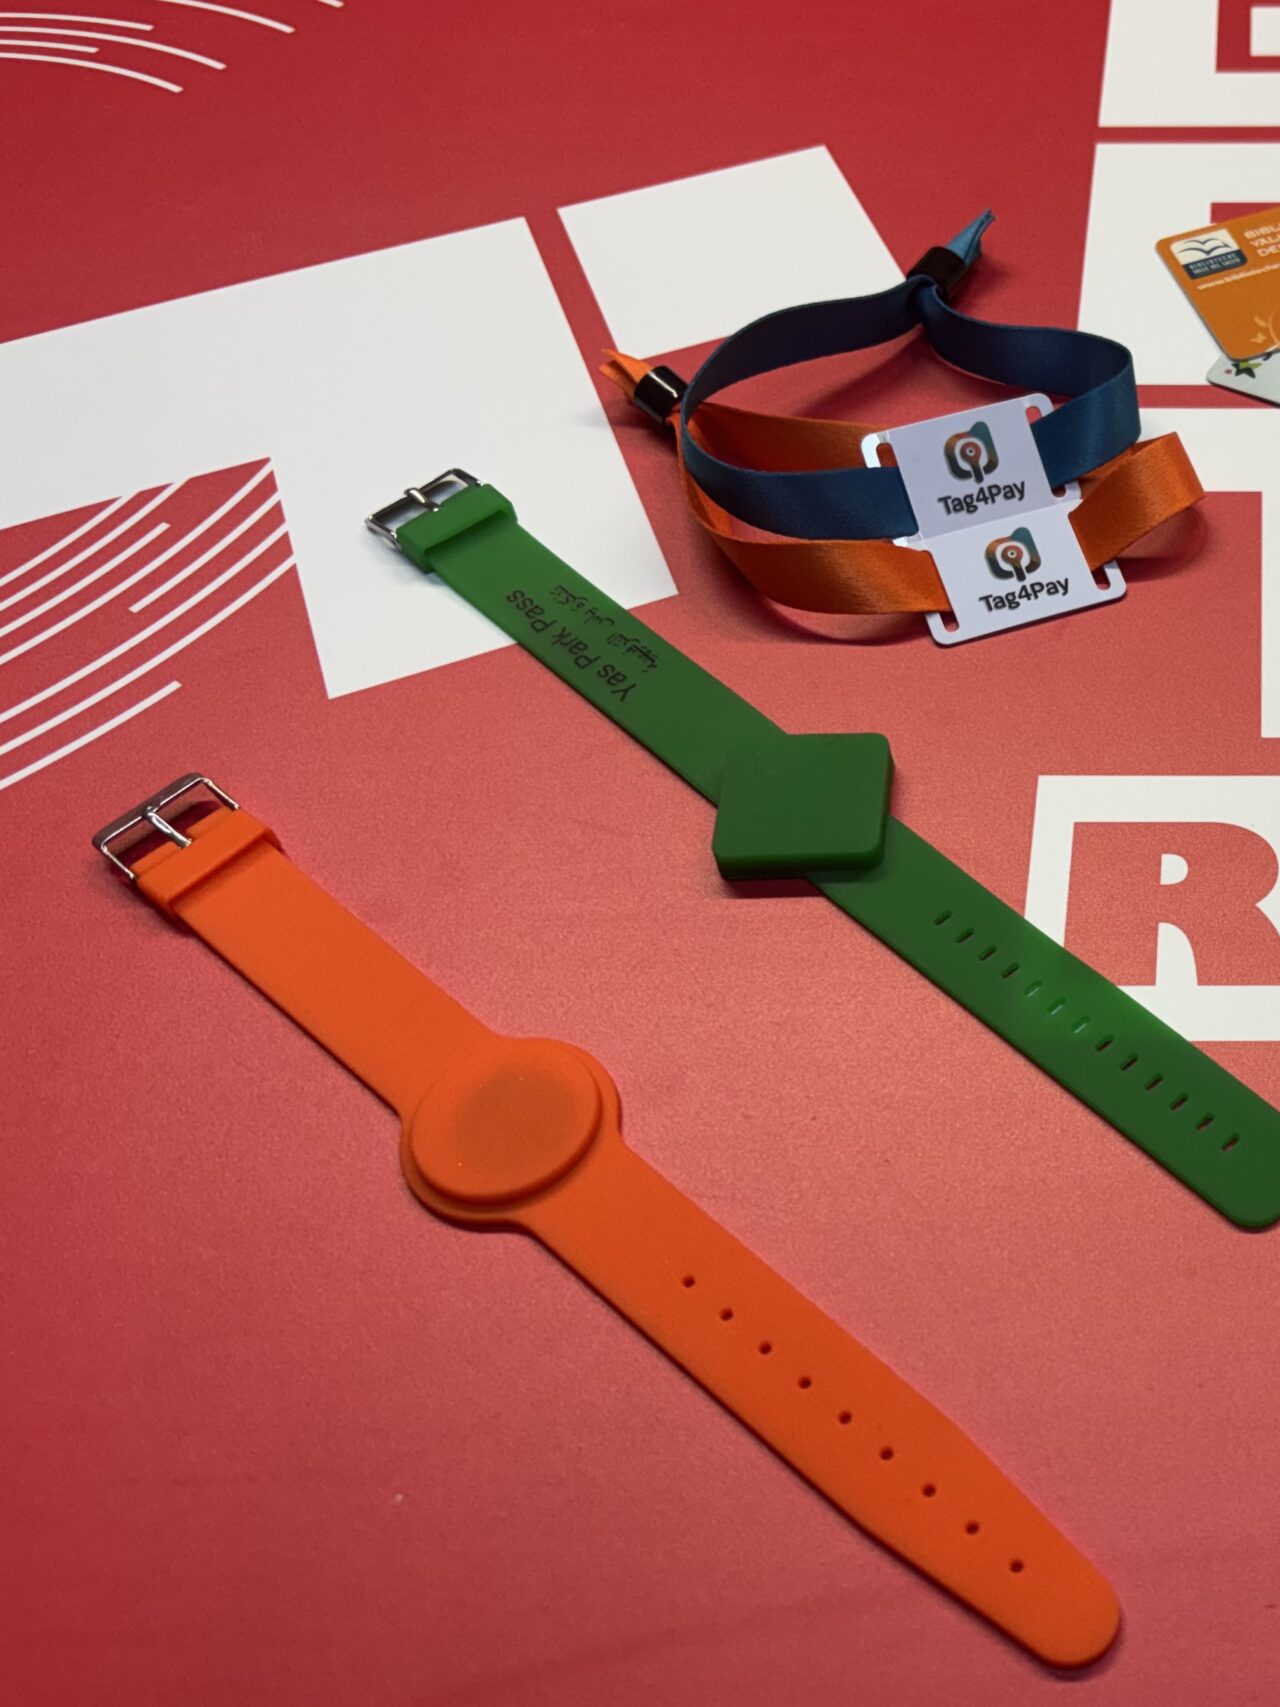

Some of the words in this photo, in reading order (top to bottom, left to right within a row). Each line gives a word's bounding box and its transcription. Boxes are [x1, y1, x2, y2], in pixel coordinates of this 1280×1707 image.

[938, 480, 1026, 515] Tag4Pay
[506, 590, 558, 633] Pass
[979, 577, 1069, 612] Tag4Pay
[552, 626, 601, 670] Park
[597, 663, 637, 702] Yas
